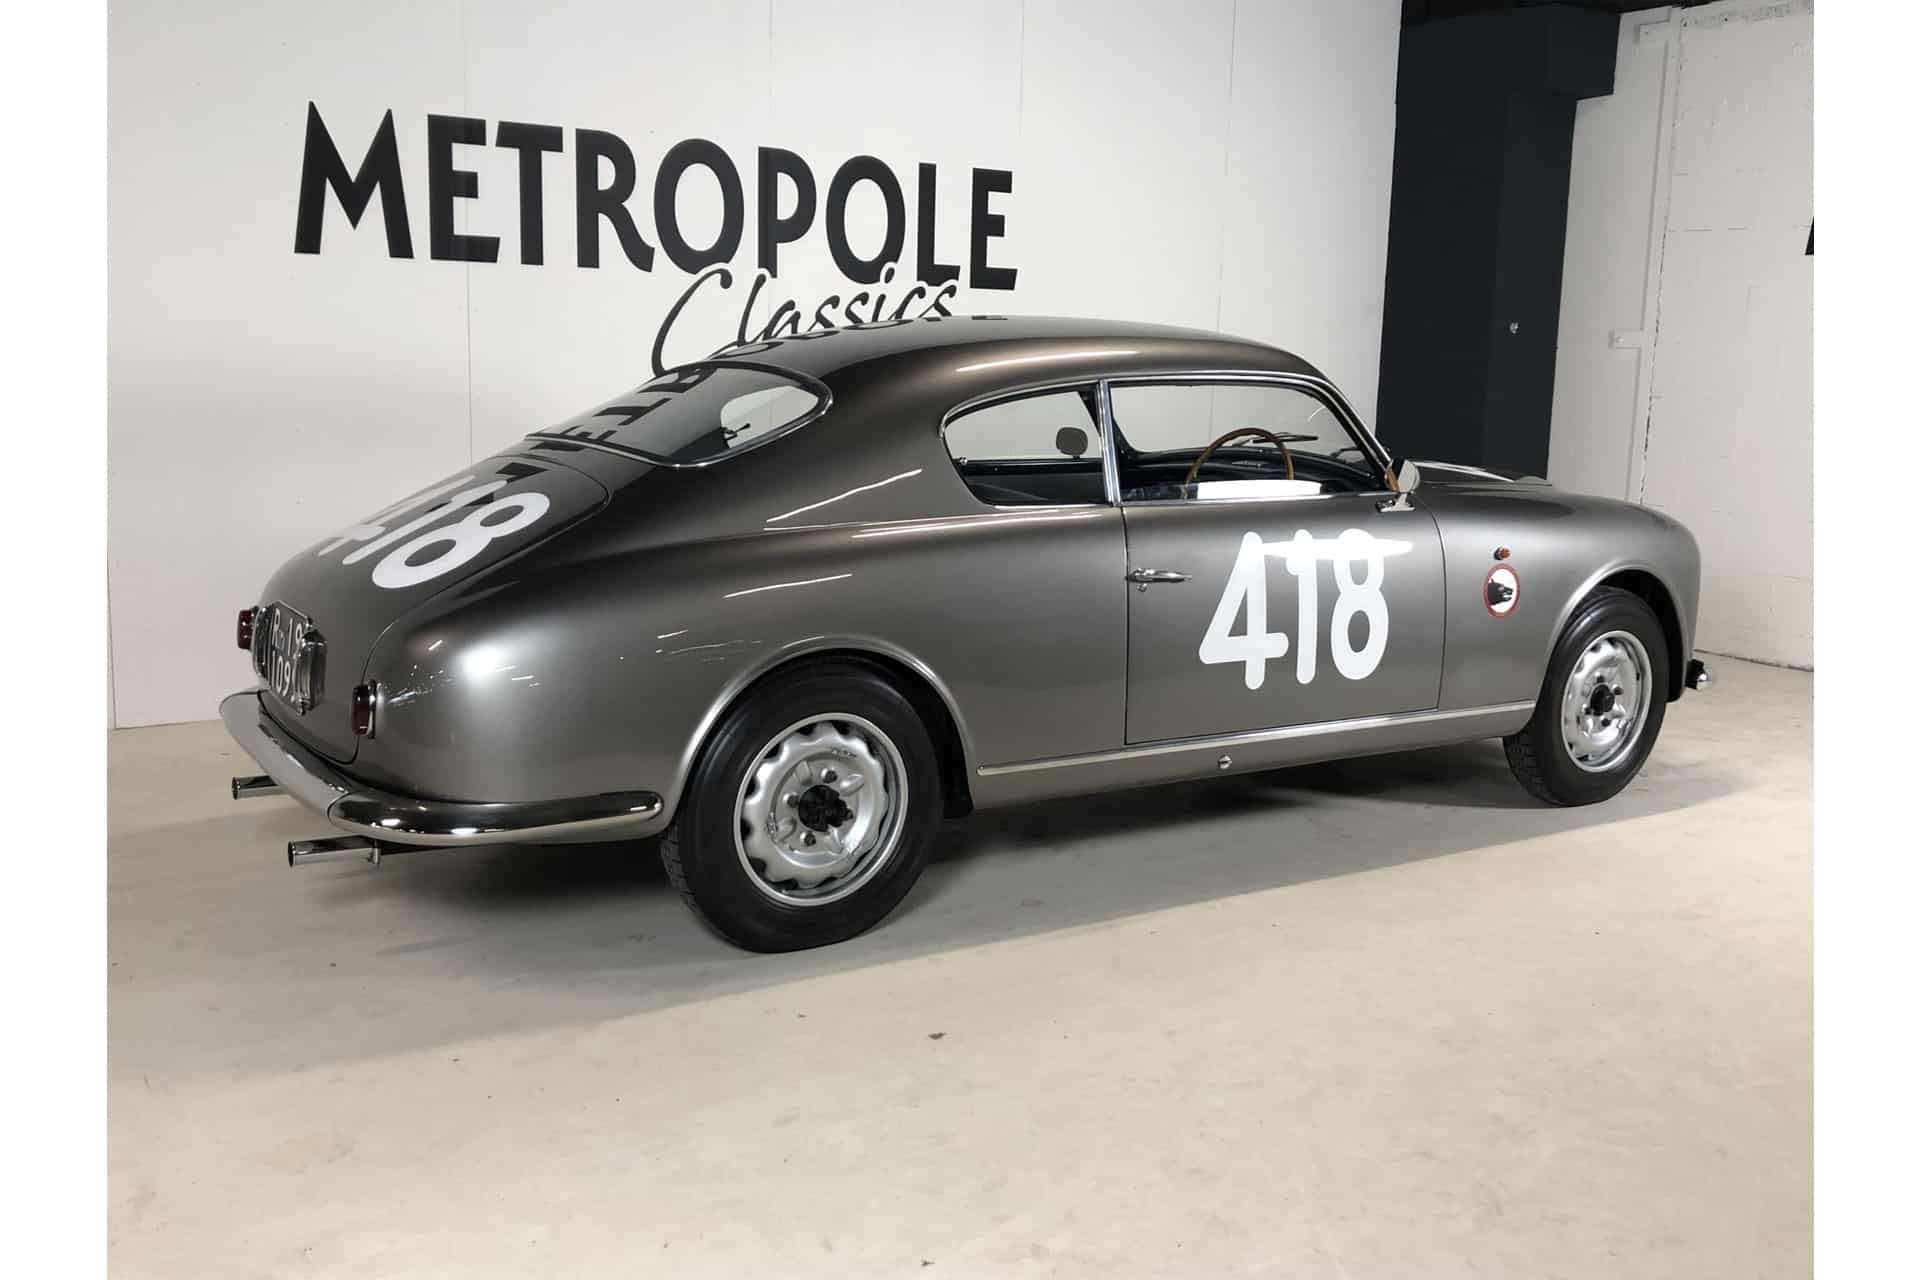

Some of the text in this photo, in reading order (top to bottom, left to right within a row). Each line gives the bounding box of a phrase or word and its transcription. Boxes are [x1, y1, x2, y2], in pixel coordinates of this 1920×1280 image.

[294, 101, 1018, 291] METROPOLE
[652, 268, 957, 378] Classics
[317, 474, 550, 589] 418
[1199, 528, 1389, 690] 418
[271, 651, 297, 698] 109
